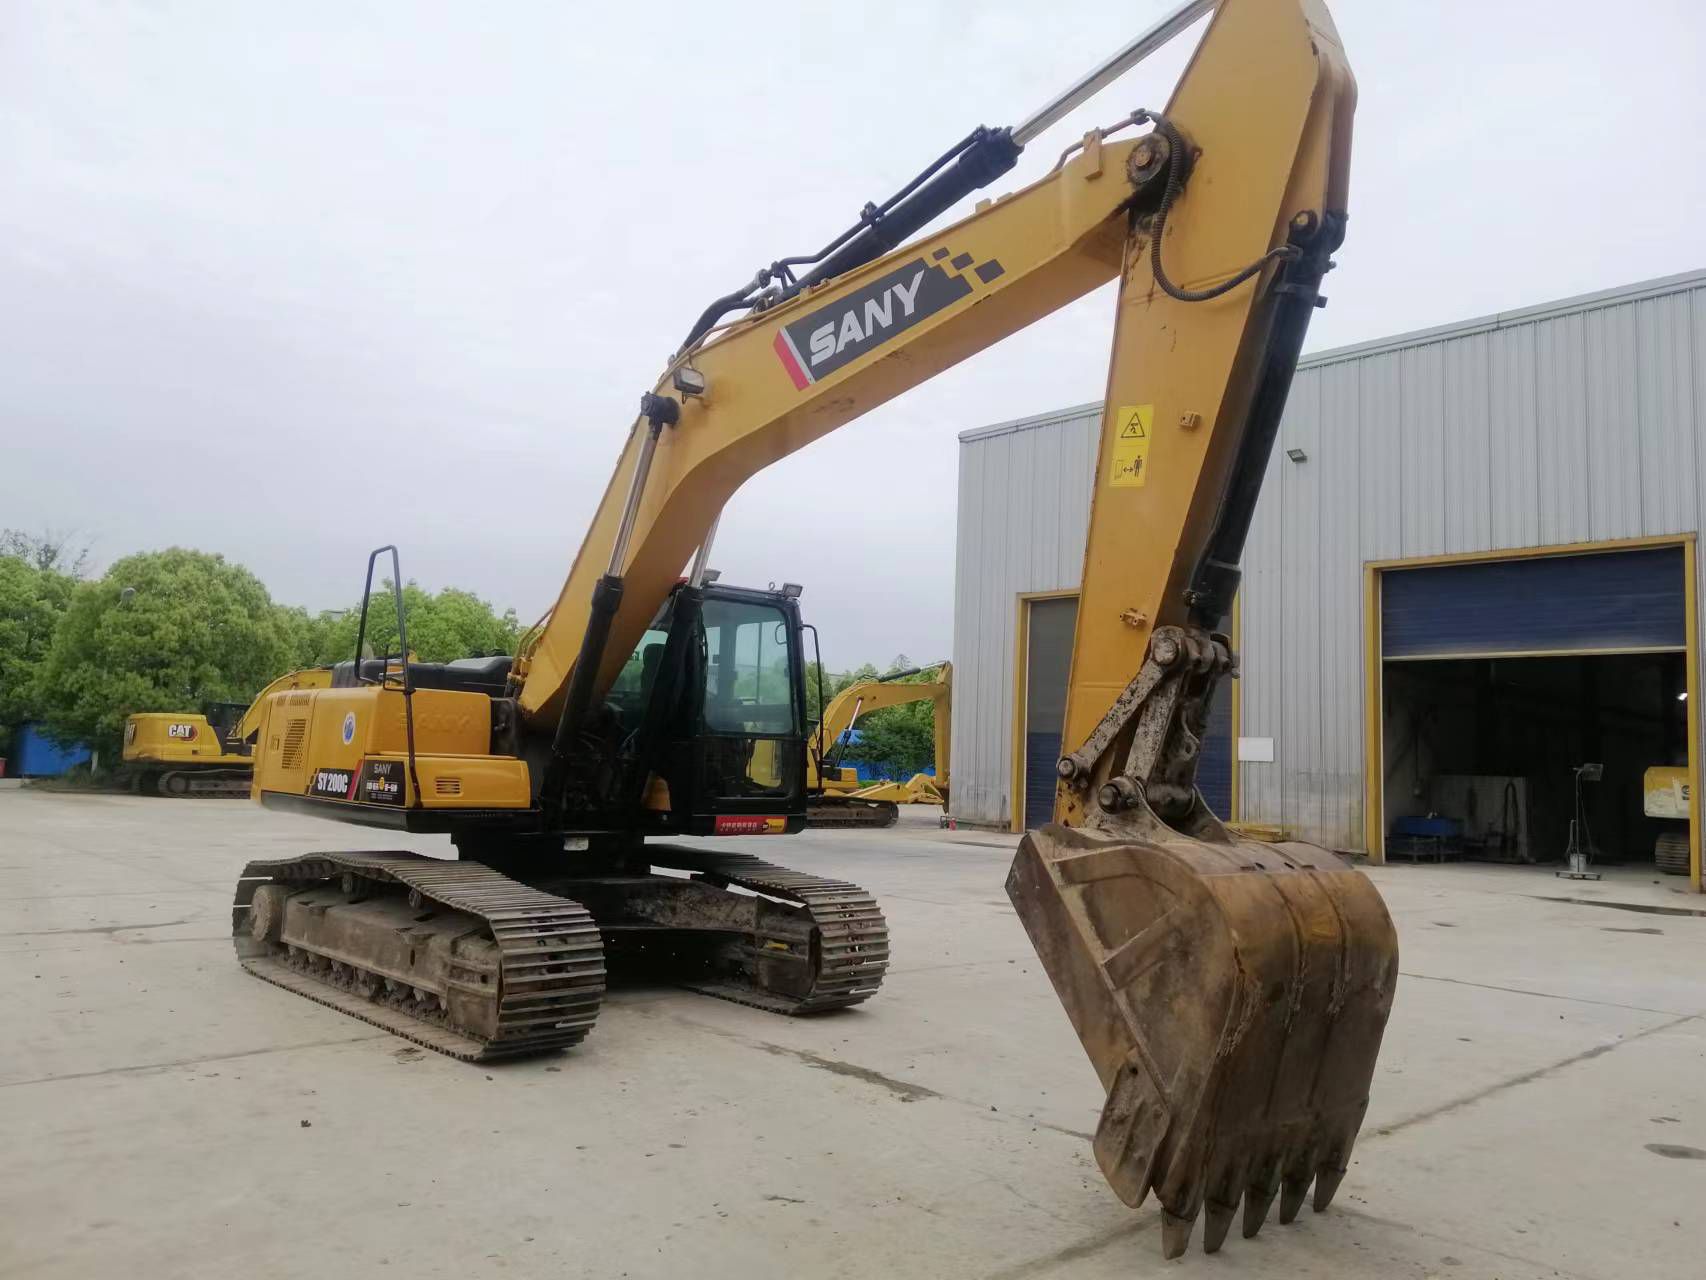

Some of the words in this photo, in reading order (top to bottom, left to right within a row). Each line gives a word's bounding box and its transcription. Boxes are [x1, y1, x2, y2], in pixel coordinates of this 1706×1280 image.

[809, 270, 925, 367] SANY
[168, 725, 192, 737] CAT
[374, 763, 392, 775] SANY
